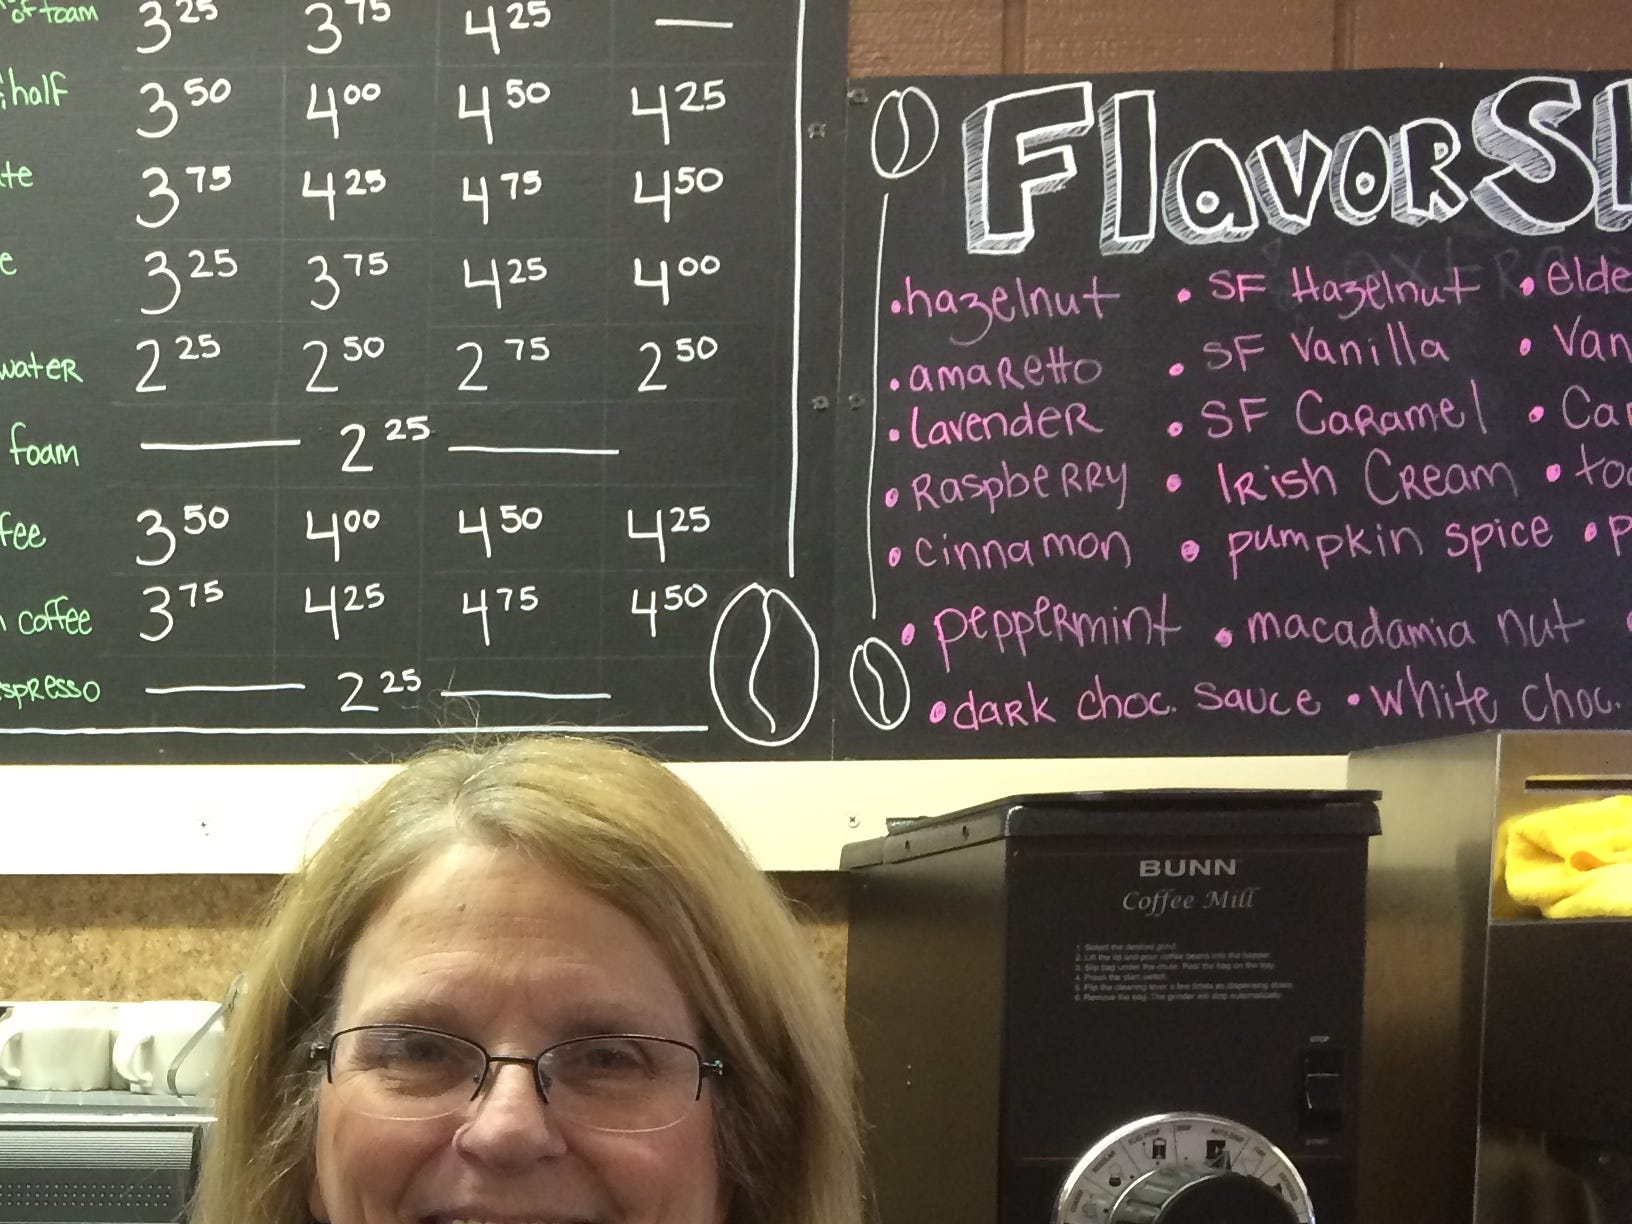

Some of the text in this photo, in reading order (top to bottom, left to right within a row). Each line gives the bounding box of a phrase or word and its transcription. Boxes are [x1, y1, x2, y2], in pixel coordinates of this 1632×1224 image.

[905, 266, 1480, 346] hazelnut SF Hazelnut
[910, 321, 1449, 392] amaretto SF Vanilla
[10, 422, 79, 467] foam
[911, 378, 1486, 449] lavender SF Caramel
[1218, 457, 1337, 505] Irish
[1365, 448, 1518, 505] Cream
[915, 515, 1553, 580] cinnamon pumpkin spice
[19, 596, 92, 635] coffee
[934, 593, 1585, 673] peppermint macadamia nut
[953, 681, 1056, 731] dark
[1371, 665, 1497, 725] white
[1139, 859, 1237, 877] BUNN
[1122, 887, 1256, 917] Coffee Mill
